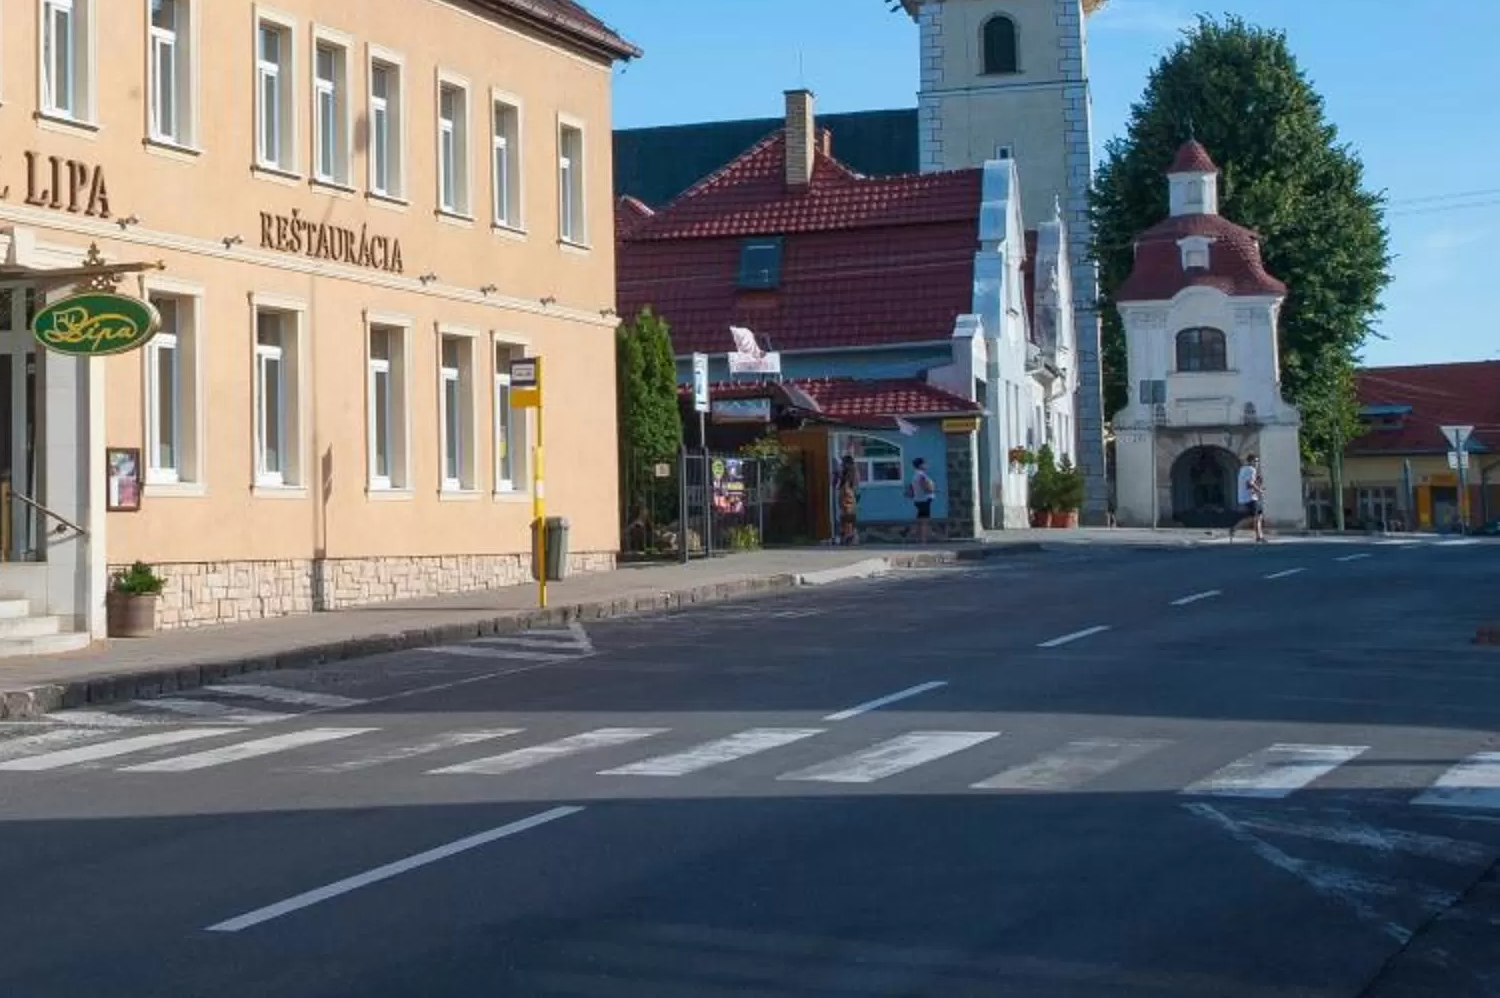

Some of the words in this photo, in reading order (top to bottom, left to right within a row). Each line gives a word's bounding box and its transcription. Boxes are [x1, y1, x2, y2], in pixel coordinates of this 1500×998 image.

[23, 150, 112, 219] LIPA
[259, 207, 404, 274] REŠTAURÁCIA
[43, 306, 138, 351] Lipa
